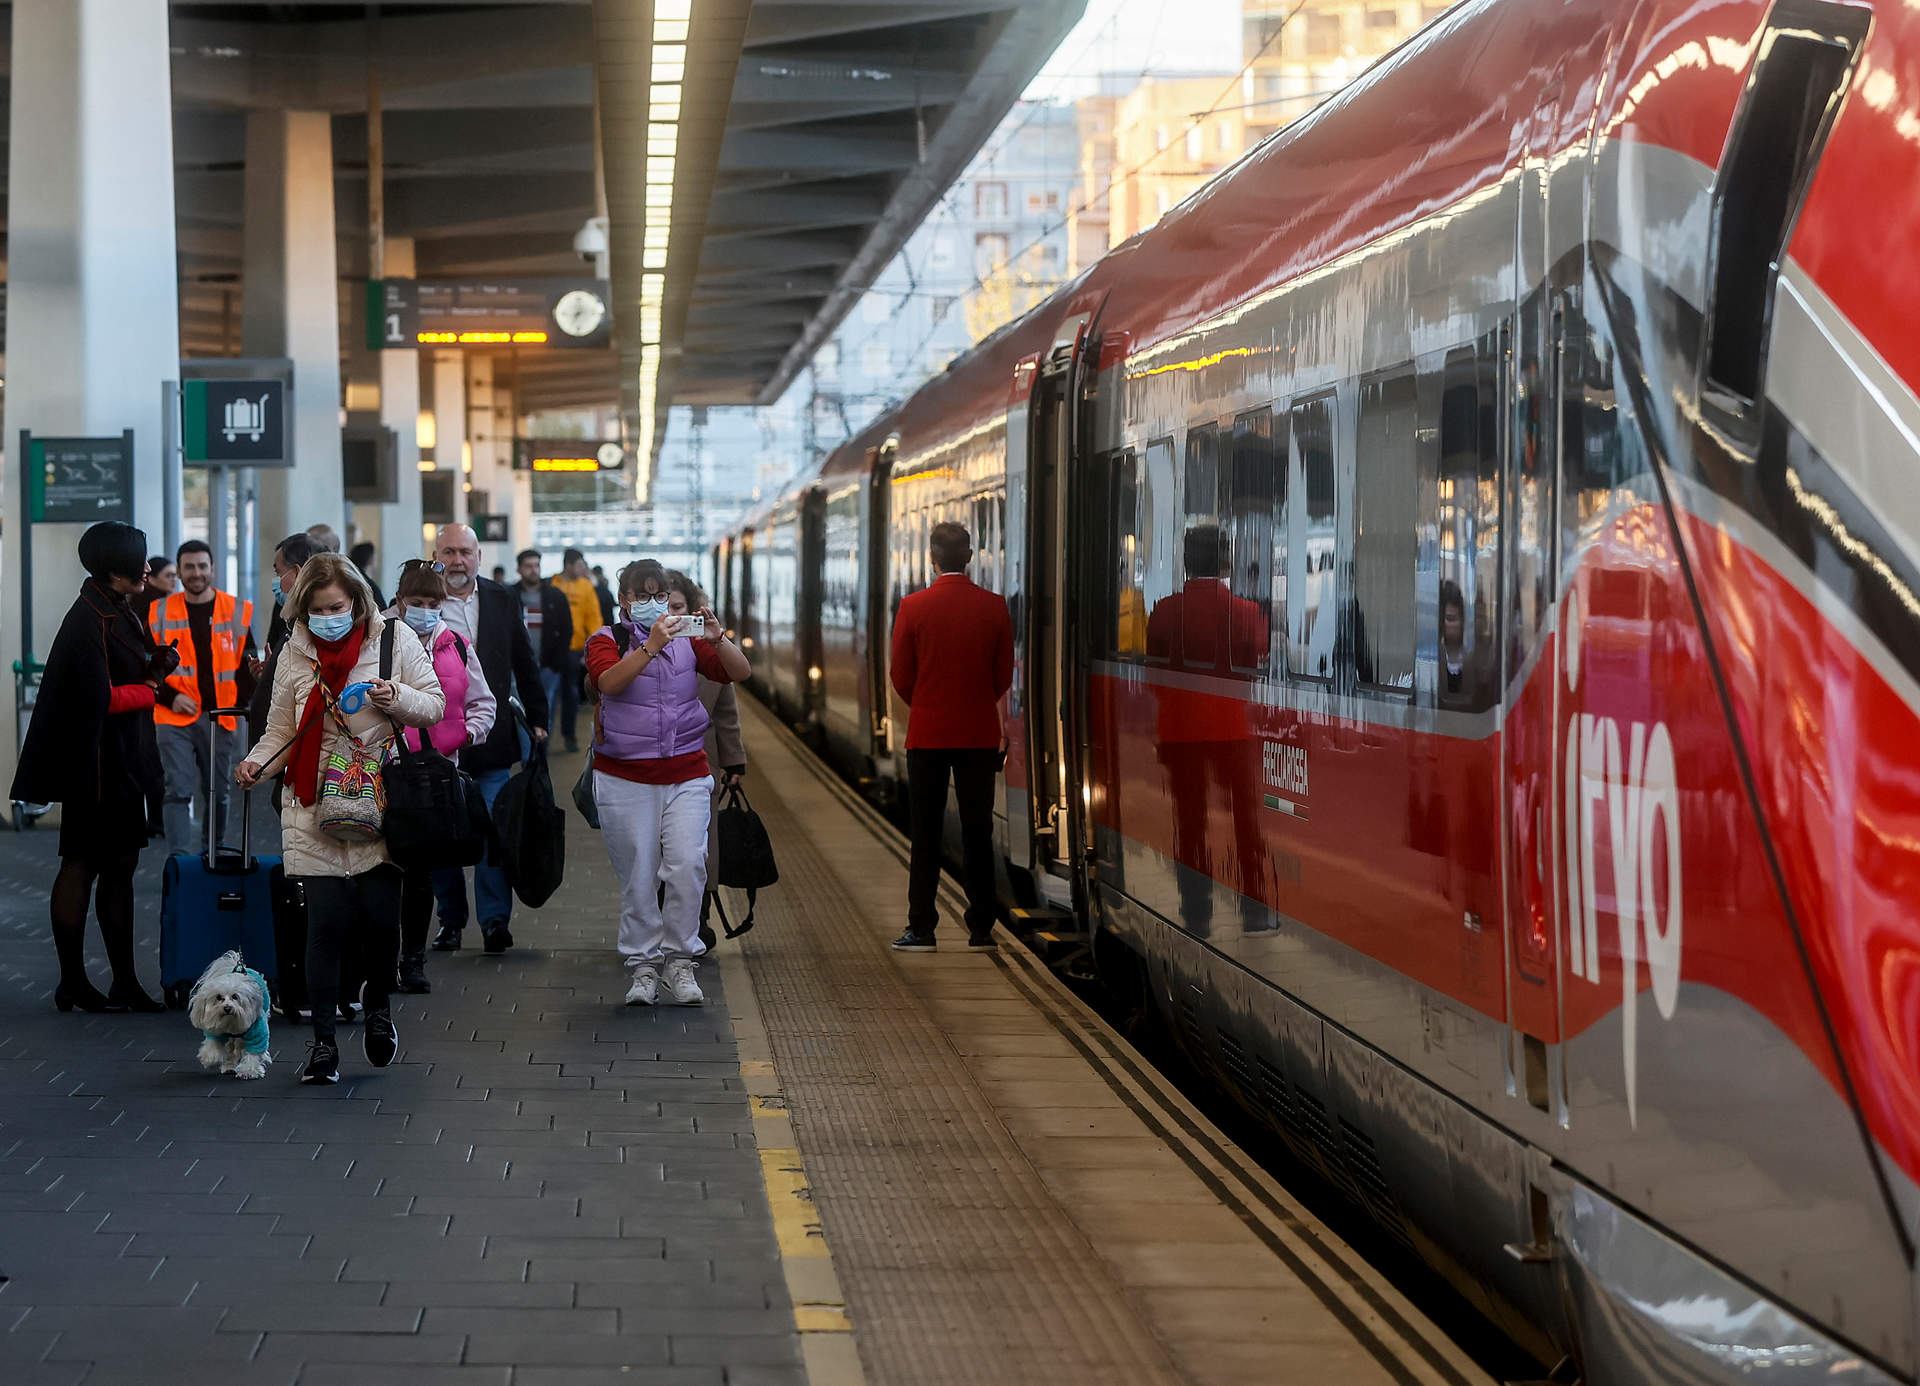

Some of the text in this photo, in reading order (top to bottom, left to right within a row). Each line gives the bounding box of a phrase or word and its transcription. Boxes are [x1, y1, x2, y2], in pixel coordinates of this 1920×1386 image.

[385, 314, 405, 342] 1
[1262, 740, 1309, 796] FRECCIAROSSA
[1564, 587, 1682, 1130] iryo
